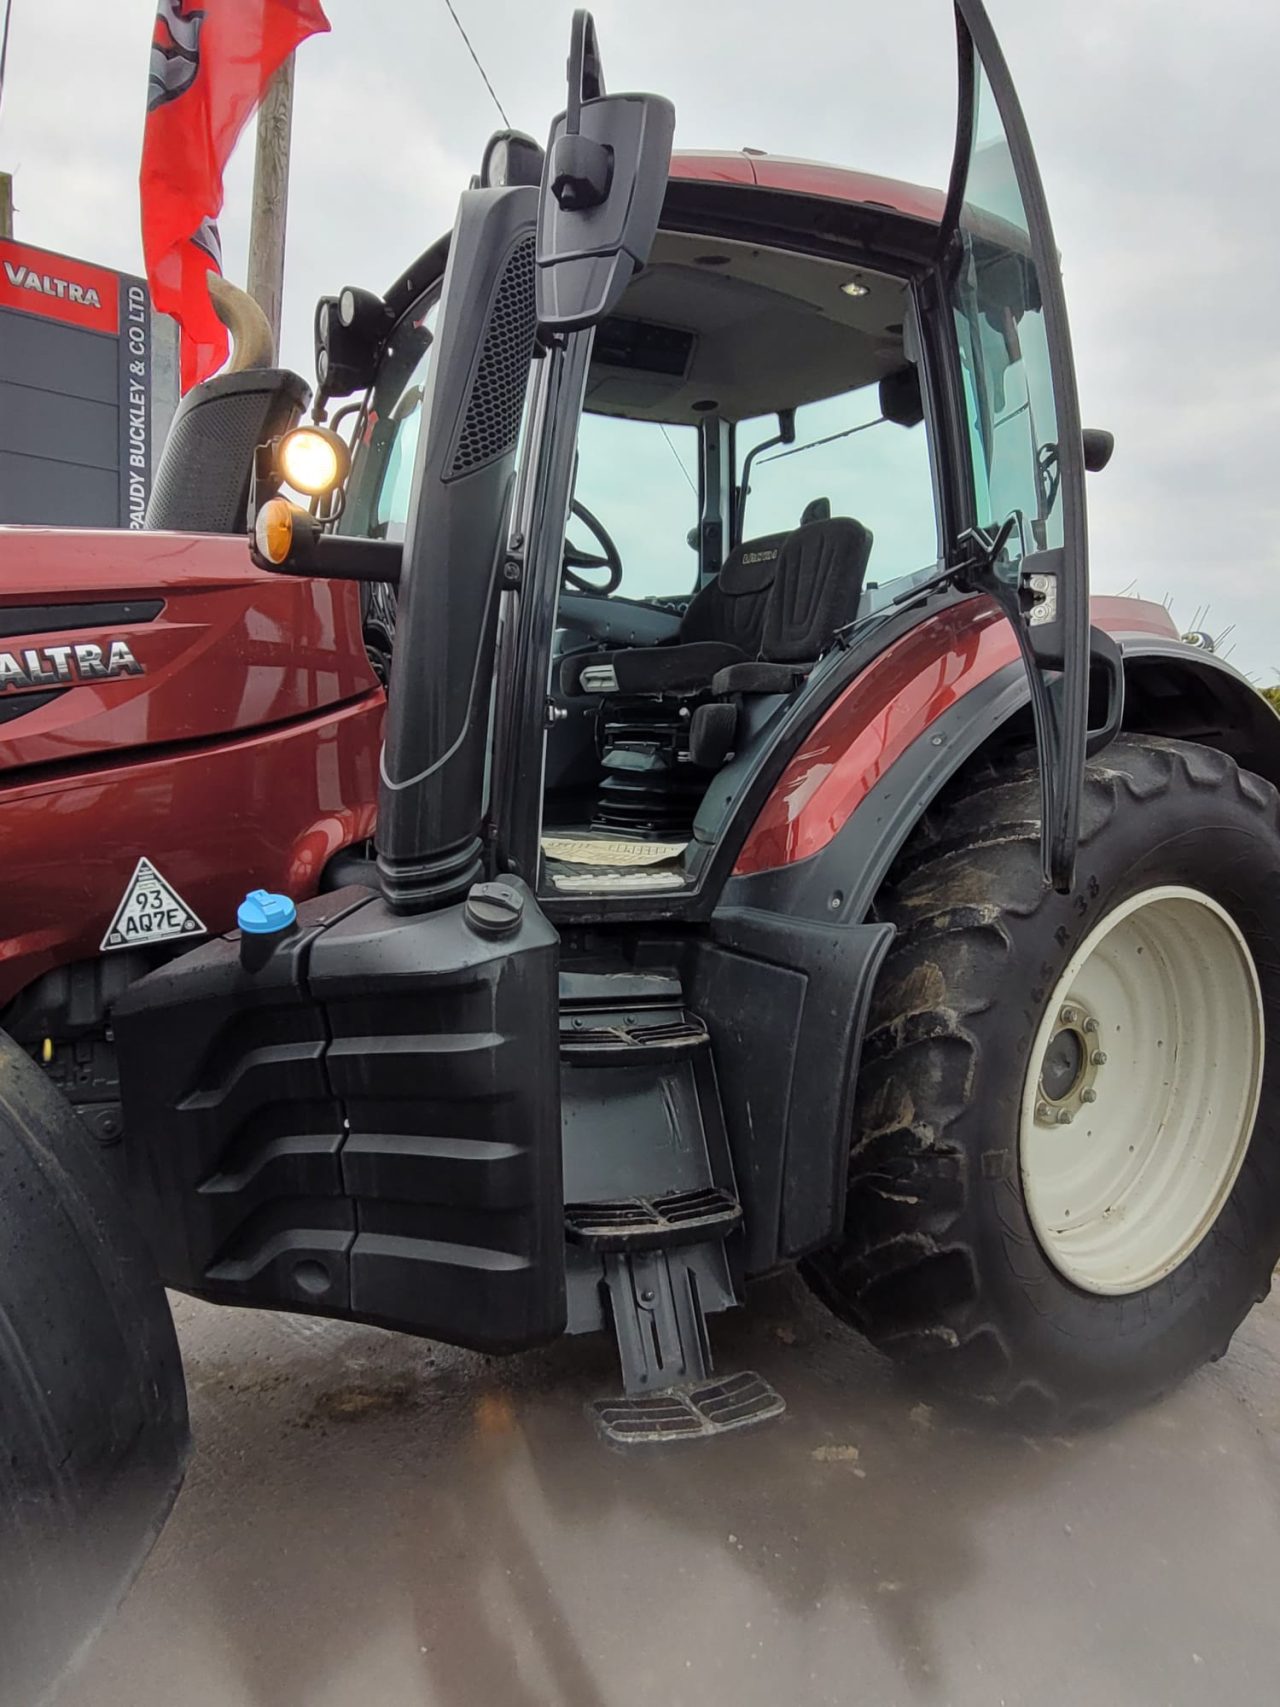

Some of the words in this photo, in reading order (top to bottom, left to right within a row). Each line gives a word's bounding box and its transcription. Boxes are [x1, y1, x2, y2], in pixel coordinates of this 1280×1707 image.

[4, 262, 101, 308] VALTRA
[128, 286, 145, 322] LTD
[128, 326, 145, 355] CO
[129, 360, 145, 376] &
[129, 379, 145, 468] BUCKLEY
[136, 890, 163, 912] 93
[126, 908, 181, 935] AQ7E
